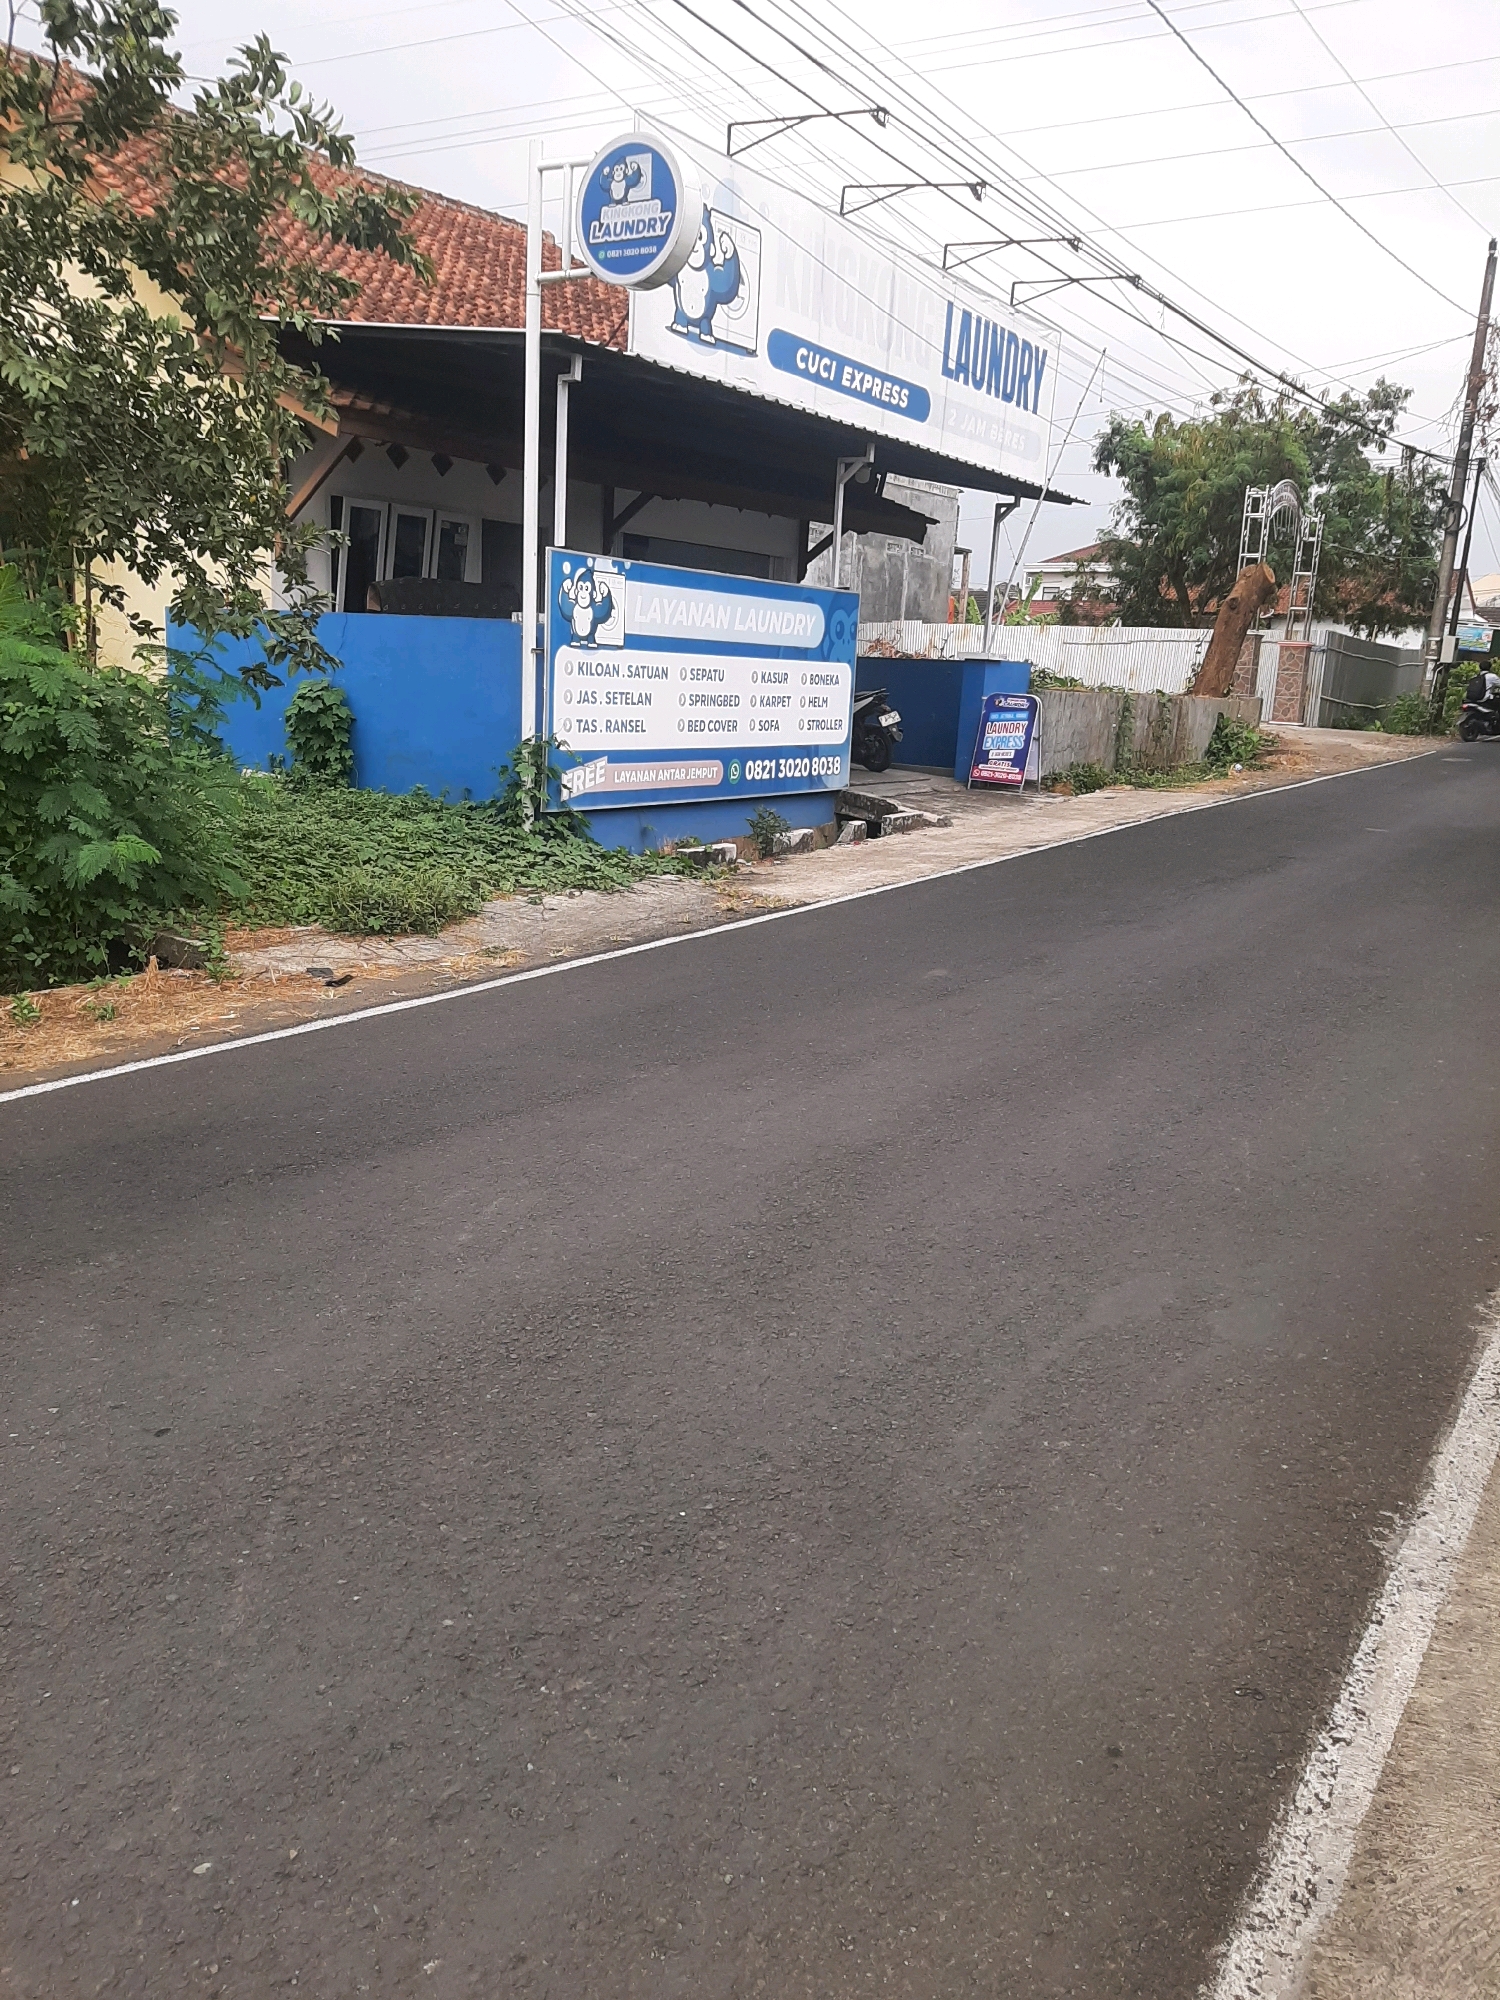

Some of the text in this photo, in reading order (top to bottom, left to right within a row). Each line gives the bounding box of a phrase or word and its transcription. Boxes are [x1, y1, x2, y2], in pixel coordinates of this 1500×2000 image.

[602, 202, 659, 220] KINGKONG
[590, 214, 671, 242] LAUNDRY
[775, 211, 1048, 415] KINGKONG LAUNDRY
[796, 347, 910, 409] CUCI EXPRESS
[947, 408, 1026, 452] 2 JAM BERES
[634, 595, 817, 637] LAYANAN LAUNDRY
[627, 664, 669, 680] SATUAN
[689, 667, 726, 682] SEPATU
[760, 671, 789, 684] KASUR
[809, 673, 840, 686] BONEKA
[605, 691, 652, 706] SETELAN
[688, 694, 740, 708] SPRINGBED
[759, 695, 792, 708] KARPET
[808, 696, 828, 708] HELM
[605, 719, 646, 733] RANSEL
[687, 719, 738, 732] BED COVER
[758, 719, 780, 732] SOFA
[806, 719, 843, 731] STROLLER
[986, 721, 1028, 735] LAUNDRY
[983, 735, 1025, 750] EXPRESS
[614, 766, 719, 784] LAYANAN ANTAR JEMPUT
[745, 755, 841, 781] 0821 3020 8038
[561, 758, 607, 800] FREE
